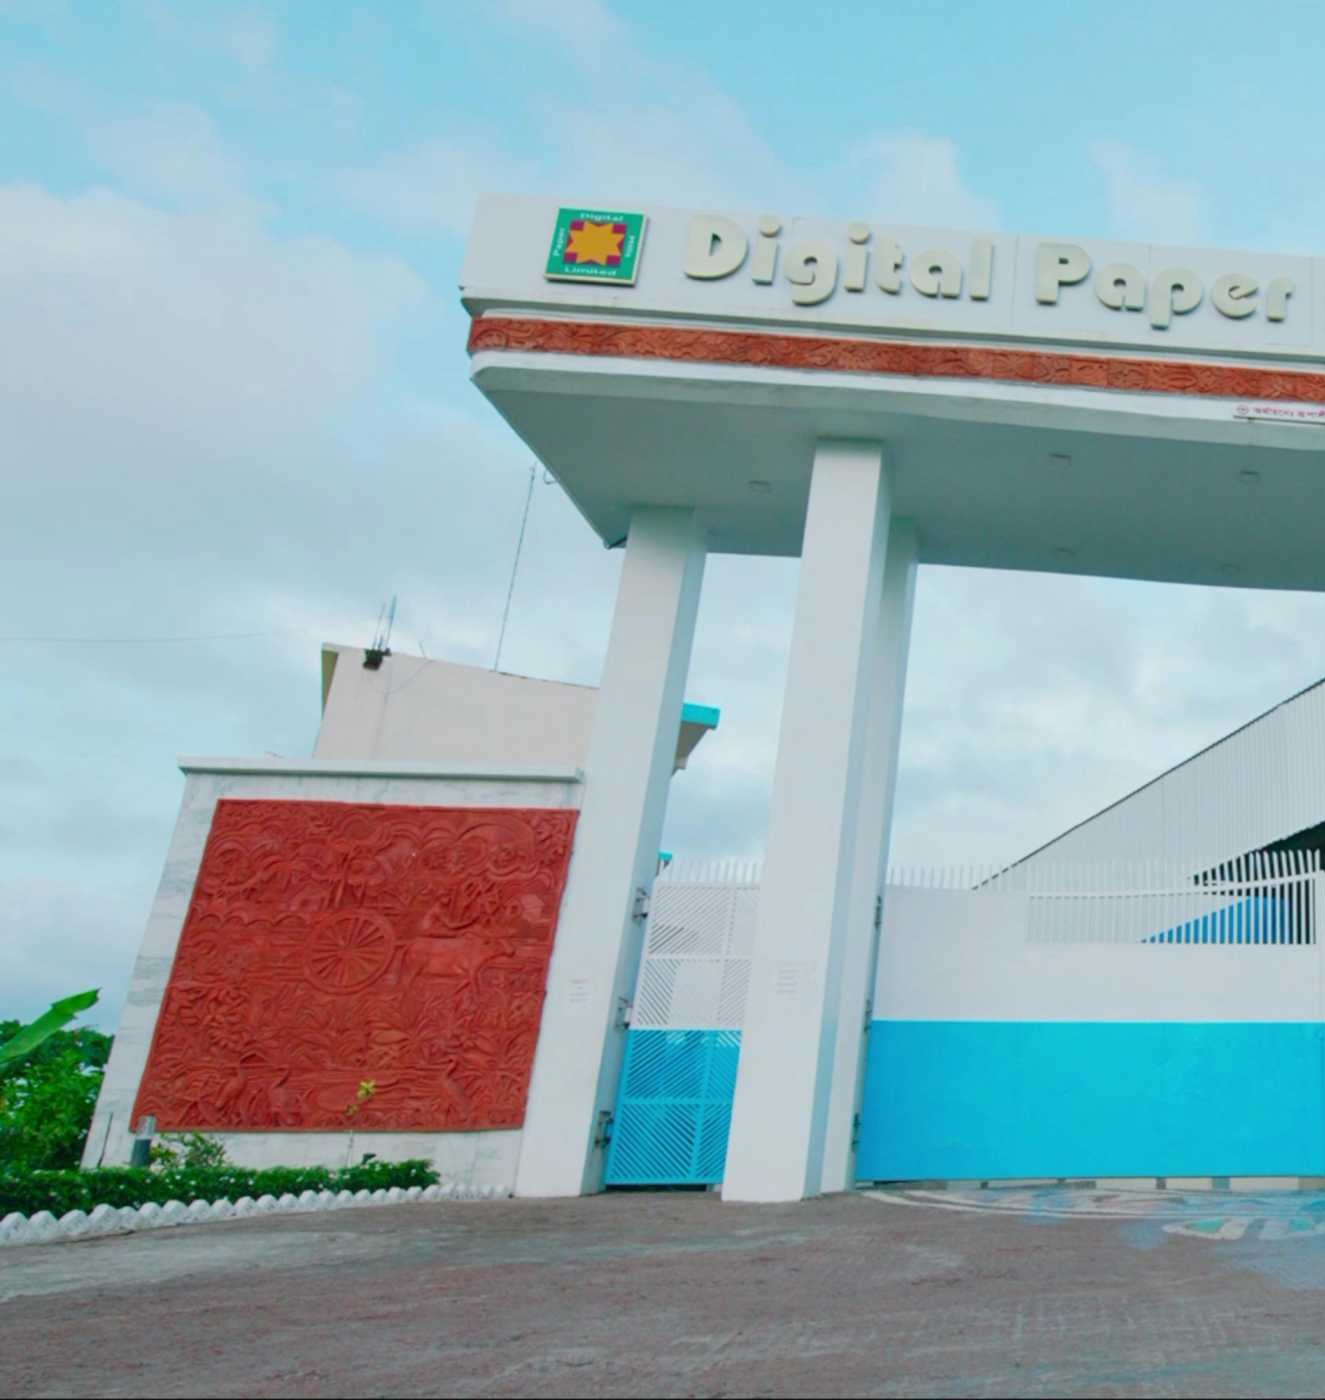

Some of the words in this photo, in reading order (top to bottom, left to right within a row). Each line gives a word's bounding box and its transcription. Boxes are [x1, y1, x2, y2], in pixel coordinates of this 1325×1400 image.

[581, 212, 623, 221] Digital
[564, 267, 616, 276] Limited
[684, 215, 996, 305] Digital
[1035, 243, 1293, 330] Paper
